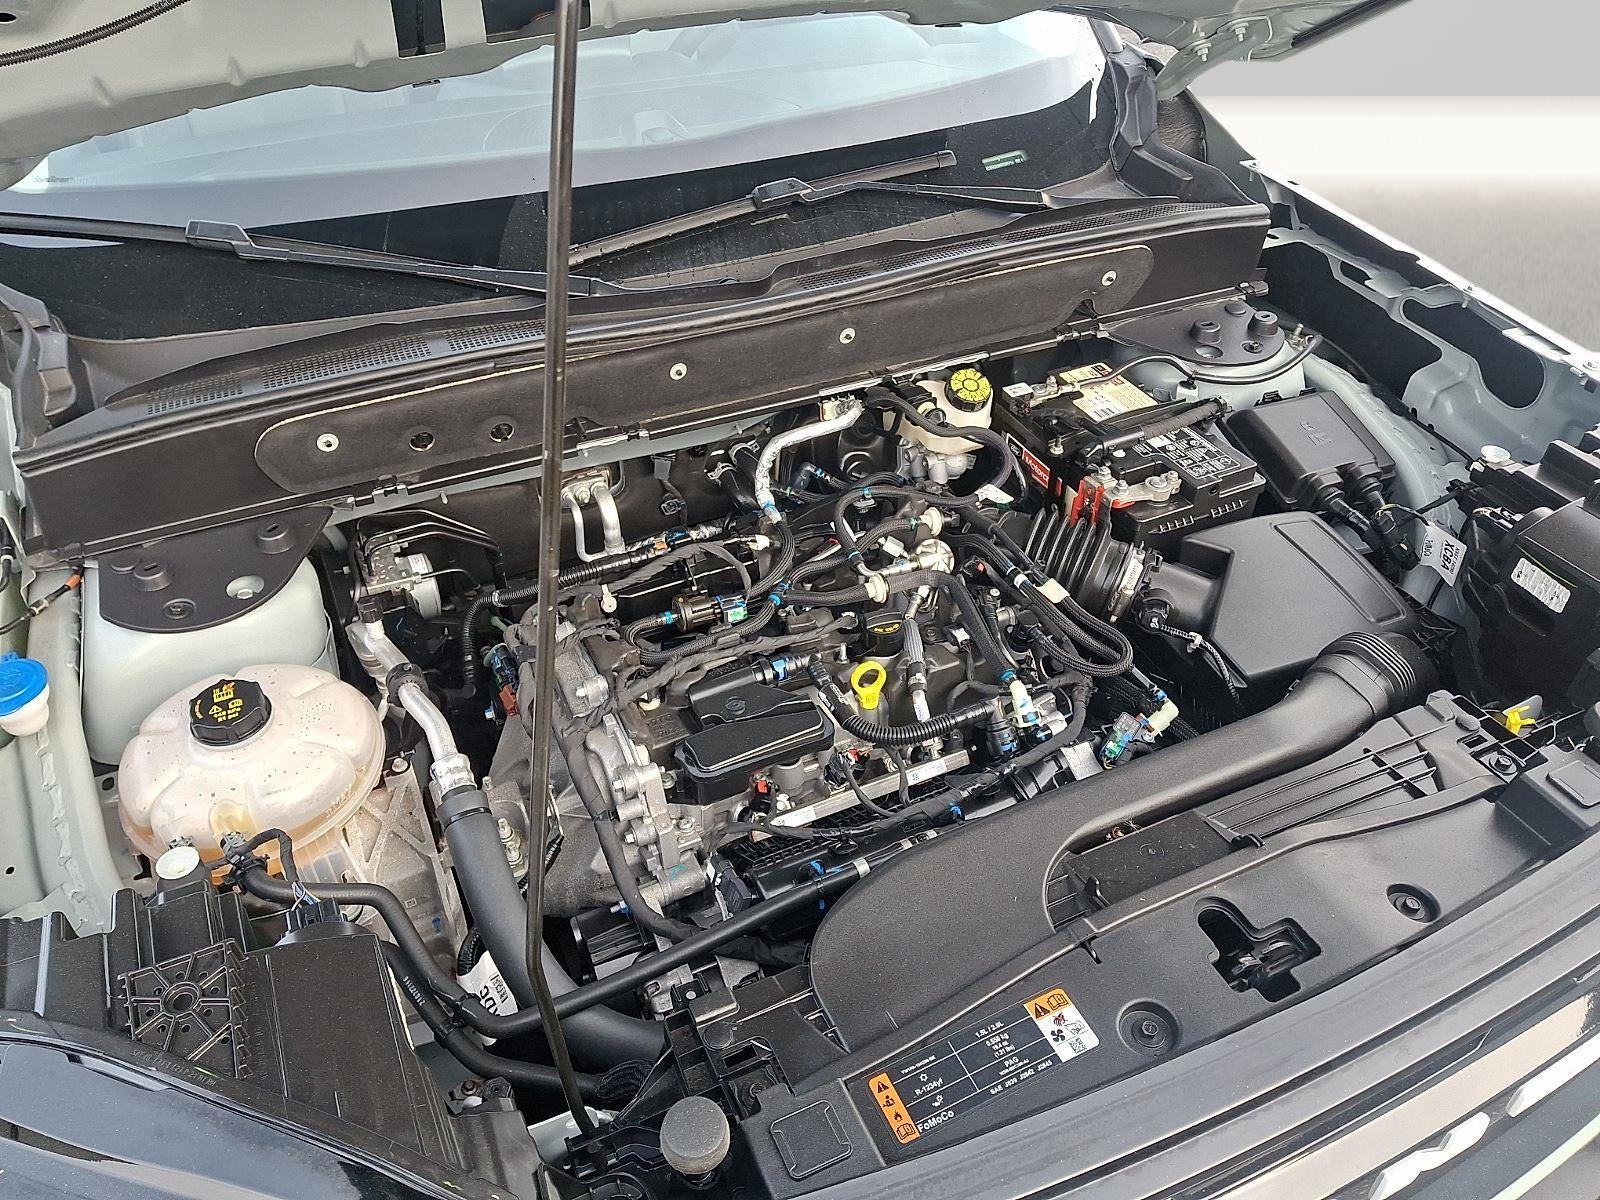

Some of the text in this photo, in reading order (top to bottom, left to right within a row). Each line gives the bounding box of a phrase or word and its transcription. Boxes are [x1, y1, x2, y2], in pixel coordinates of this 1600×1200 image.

[1441, 539, 1455, 571] XCBA
[1000, 1032, 1010, 1040] kg
[1004, 1056, 1019, 1068] PAG
[989, 1084, 1004, 1095] SAE
[917, 1110, 955, 1133] FoMoCo
